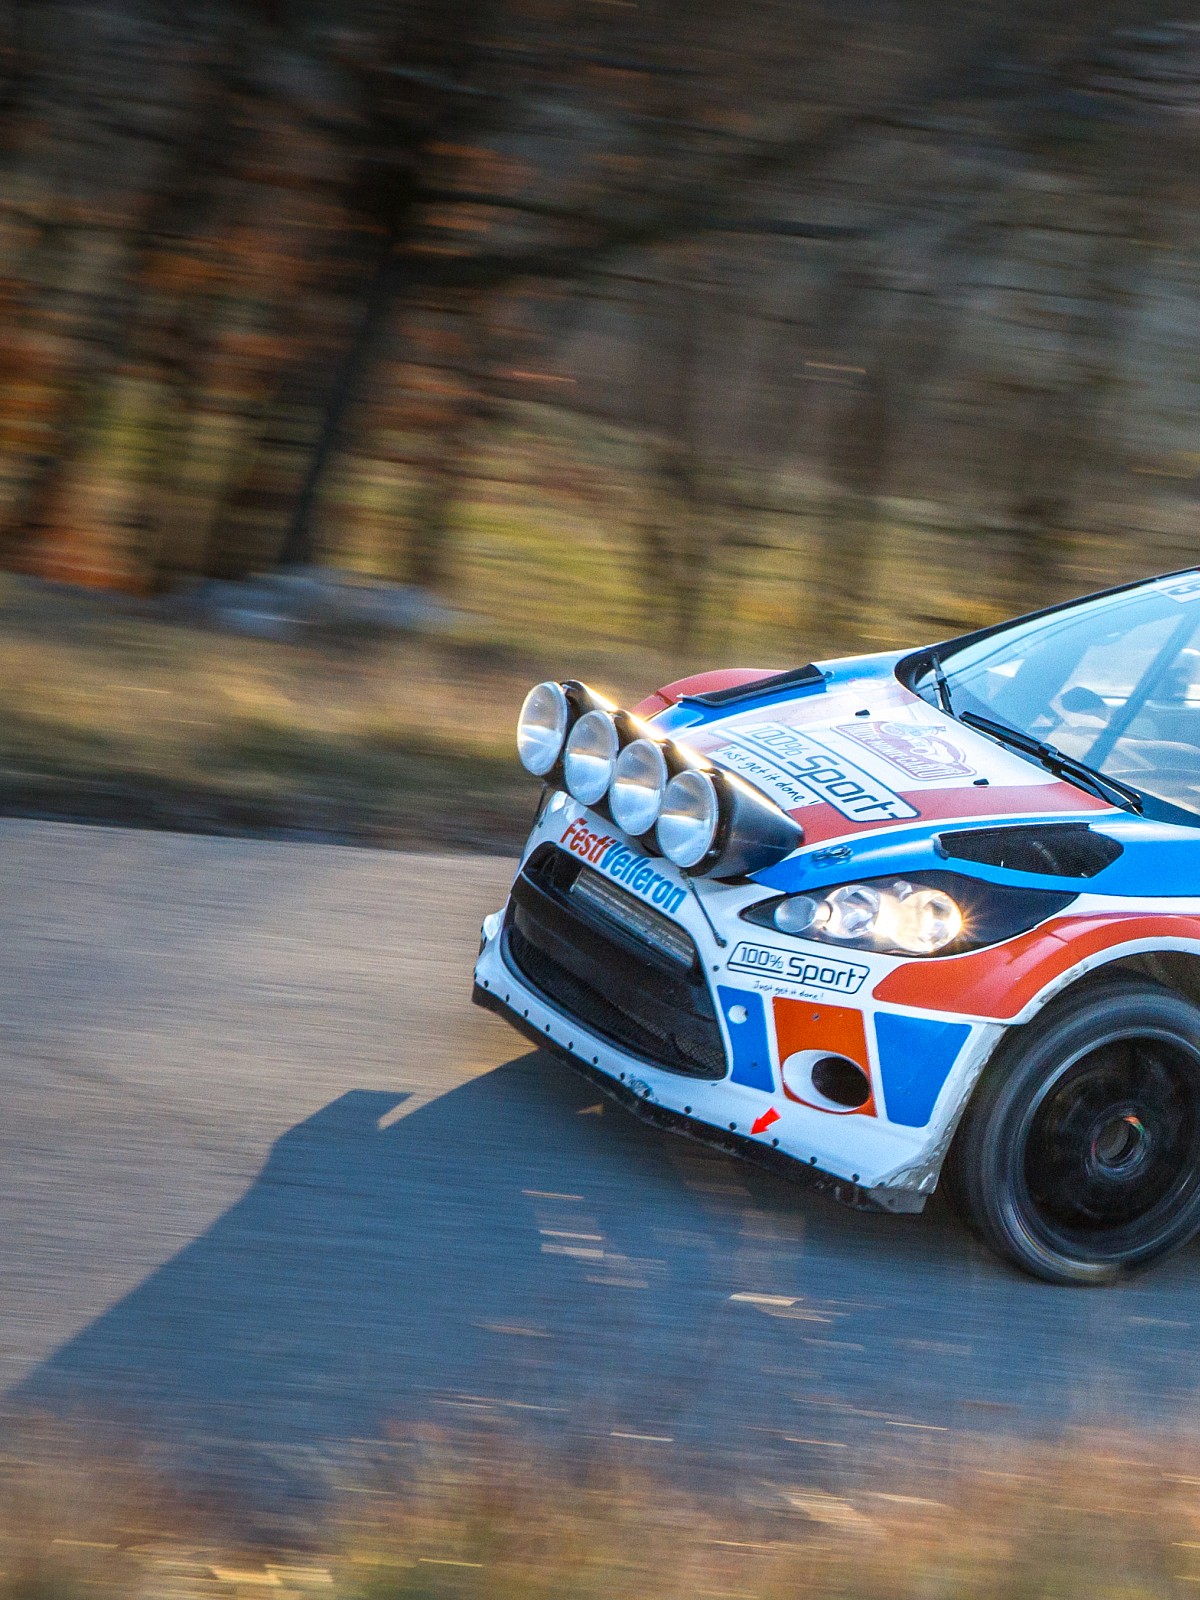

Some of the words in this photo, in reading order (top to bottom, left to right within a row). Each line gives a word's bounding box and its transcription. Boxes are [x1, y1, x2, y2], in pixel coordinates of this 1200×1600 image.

[715, 746, 750, 762] Just
[737, 762, 770, 774] get
[763, 773, 781, 781] it
[744, 725, 808, 757] 100%
[786, 755, 896, 814] Sport
[741, 947, 784, 970] 100%
[786, 956, 856, 988] Sport
